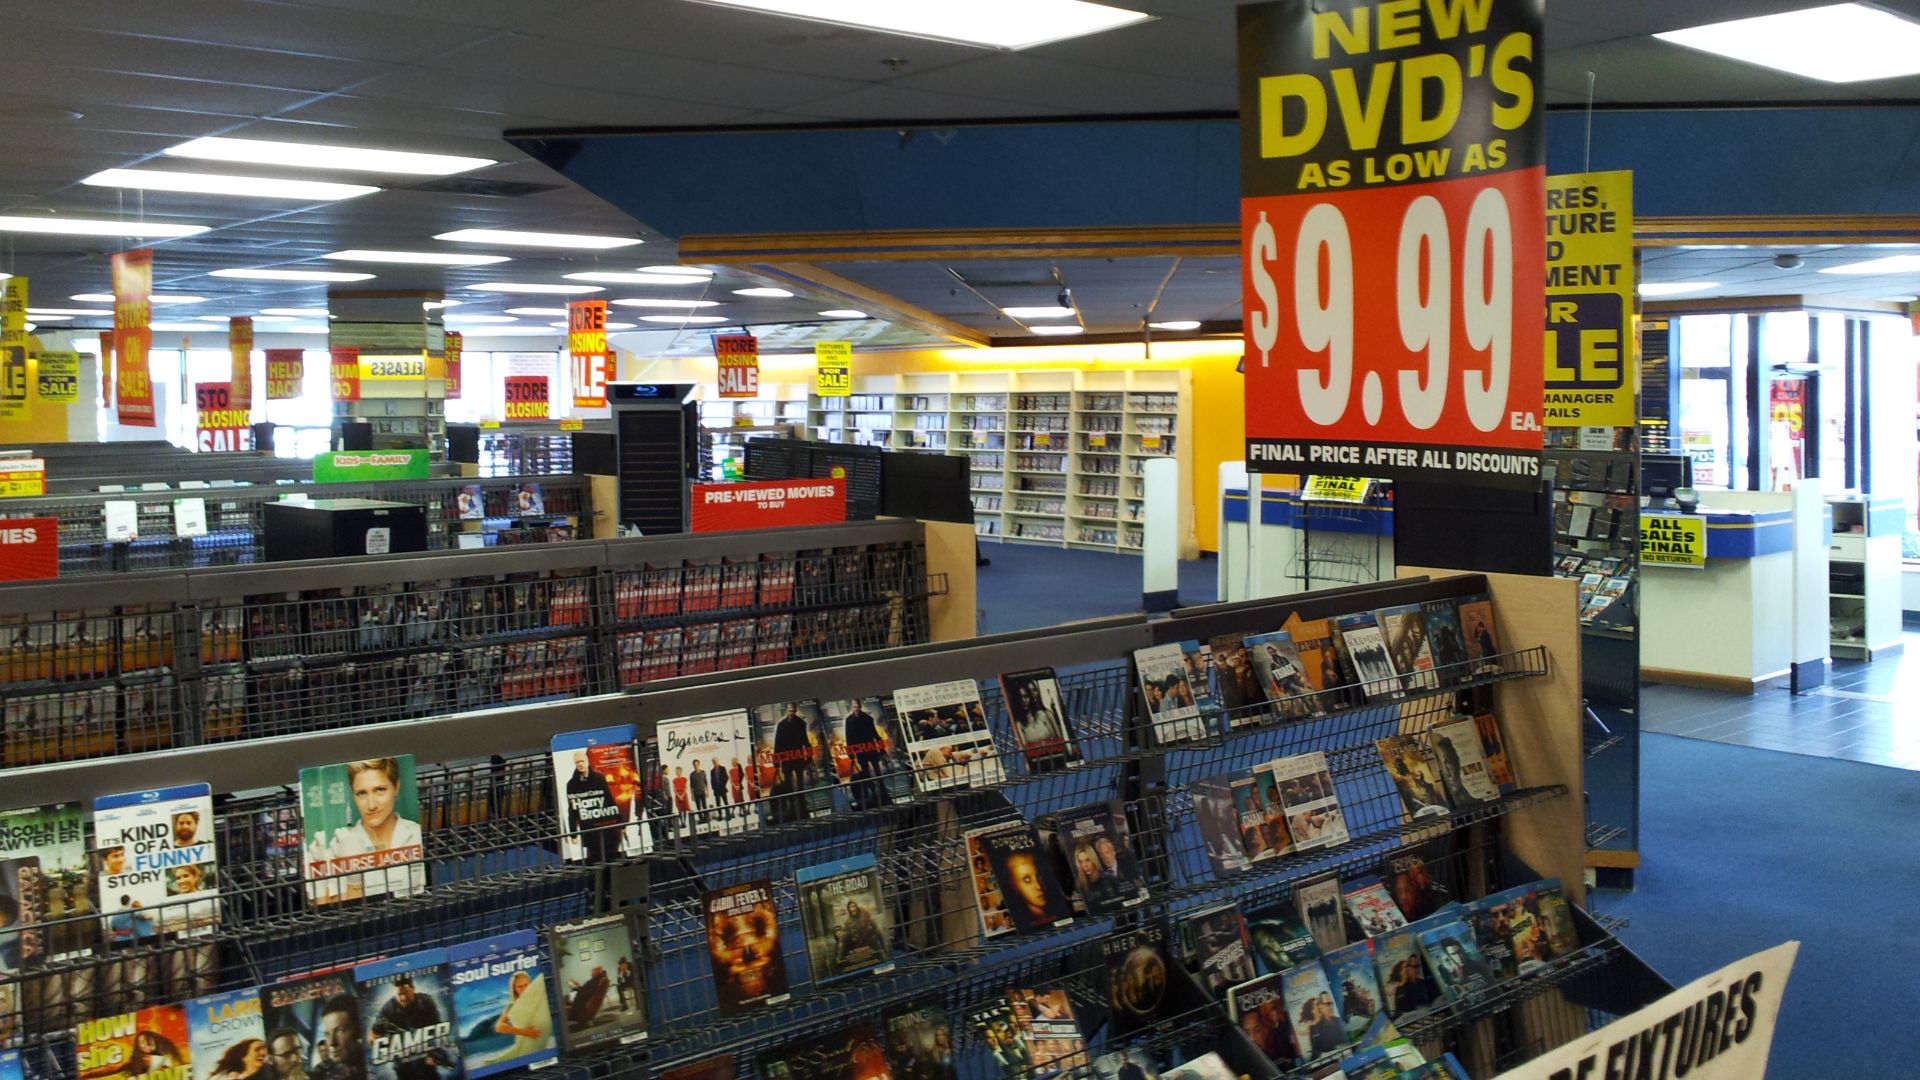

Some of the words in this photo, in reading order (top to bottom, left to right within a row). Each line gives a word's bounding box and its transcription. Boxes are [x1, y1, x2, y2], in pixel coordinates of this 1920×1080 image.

[1313, 0, 1493, 59] NEW
[1258, 31, 1535, 159] DVD'S
[1298, 161, 1351, 189] AS
[1365, 148, 1451, 184] LOW
[1462, 139, 1507, 173] AS
[1545, 301, 1578, 323] R
[718, 337, 756, 353] STORE
[718, 354, 757, 366] CLOSING
[269, 361, 302, 379] HELD
[40, 383, 76, 394] SALE
[719, 367, 758, 393] SALE
[818, 374, 848, 387] SALE
[506, 382, 548, 401] STORE
[505, 402, 549, 417] CLOSING
[1511, 411, 1541, 432] EA.
[371, 453, 412, 465] FAMILY
[1250, 444, 1305, 462] FINAL
[1310, 445, 1360, 464] PRICE
[1364, 448, 1418, 467] AFTER
[1421, 449, 1452, 470] ALL
[1455, 451, 1539, 477] DISCOUNTS
[705, 488, 785, 504] PRE-VIEWED
[788, 485, 835, 499] MOVIES
[1315, 481, 1356, 490] FINAL
[1649, 518, 1682, 530] ALL
[1640, 530, 1695, 542] SALES
[1640, 541, 1693, 553] FINAL
[1656, 554, 1692, 563] RETURNS
[572, 796, 605, 811] Harry
[580, 805, 619, 821] Brown
[121, 823, 169, 843] KIND
[134, 840, 156, 854] OF
[160, 839, 171, 851] A
[136, 846, 204, 871] FUNNY
[331, 855, 375, 875] NURSE
[378, 848, 421, 867] JACKIE
[107, 870, 161, 888] STORY
[828, 881, 843, 895] THE
[845, 875, 868, 893] ROAD
[711, 896, 735, 913] CABIN
[736, 890, 761, 906] FEVER
[761, 888, 768, 900] 2
[453, 964, 489, 985] soul
[491, 955, 539, 977] surfer
[78, 1013, 137, 1044] HOW
[1605, 971, 1763, 1080] FIXTURES
[372, 1022, 451, 1065] GAMER
